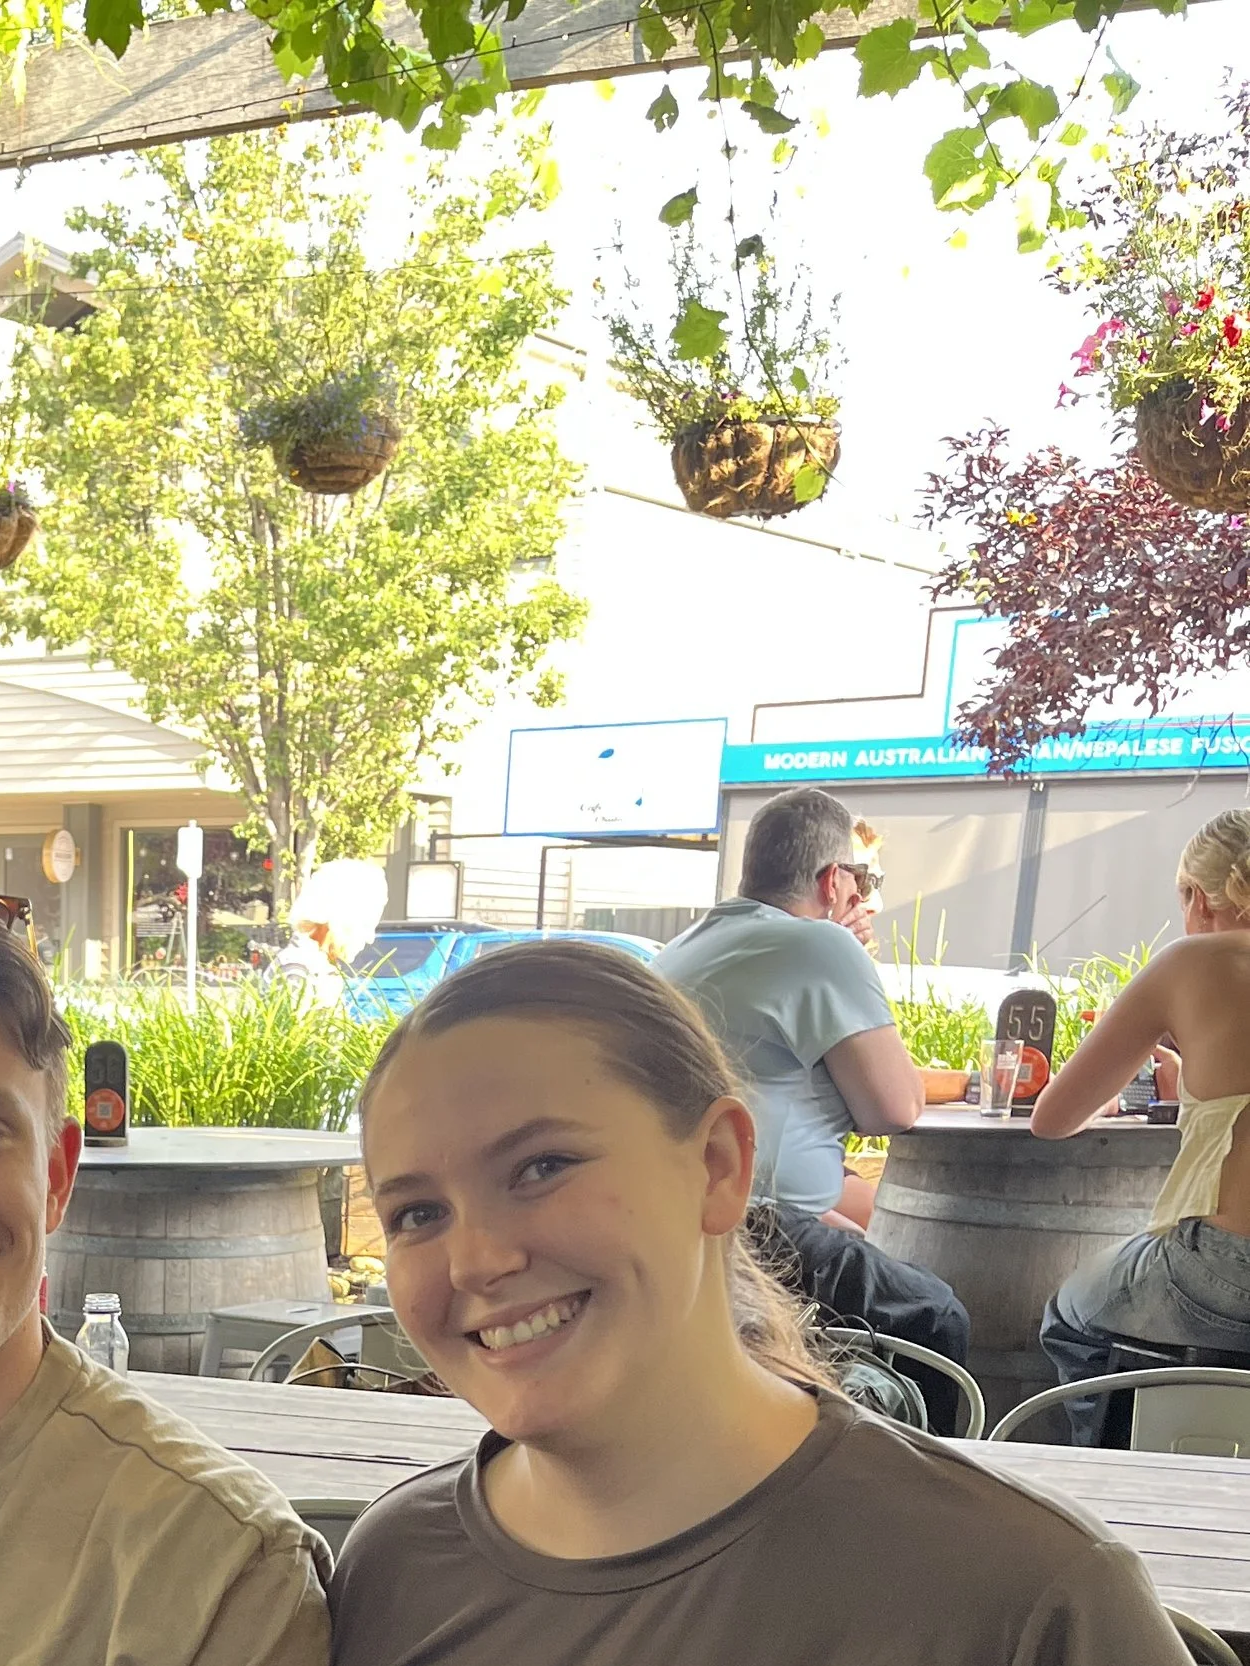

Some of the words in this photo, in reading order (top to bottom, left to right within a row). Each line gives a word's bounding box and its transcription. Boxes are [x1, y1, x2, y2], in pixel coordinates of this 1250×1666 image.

[764, 750, 848, 770] MODERN
[855, 745, 988, 767] AUSTRALIAN
[1000, 735, 1184, 764] IAN/NEPALESE
[1006, 1005, 1046, 1040] 55
